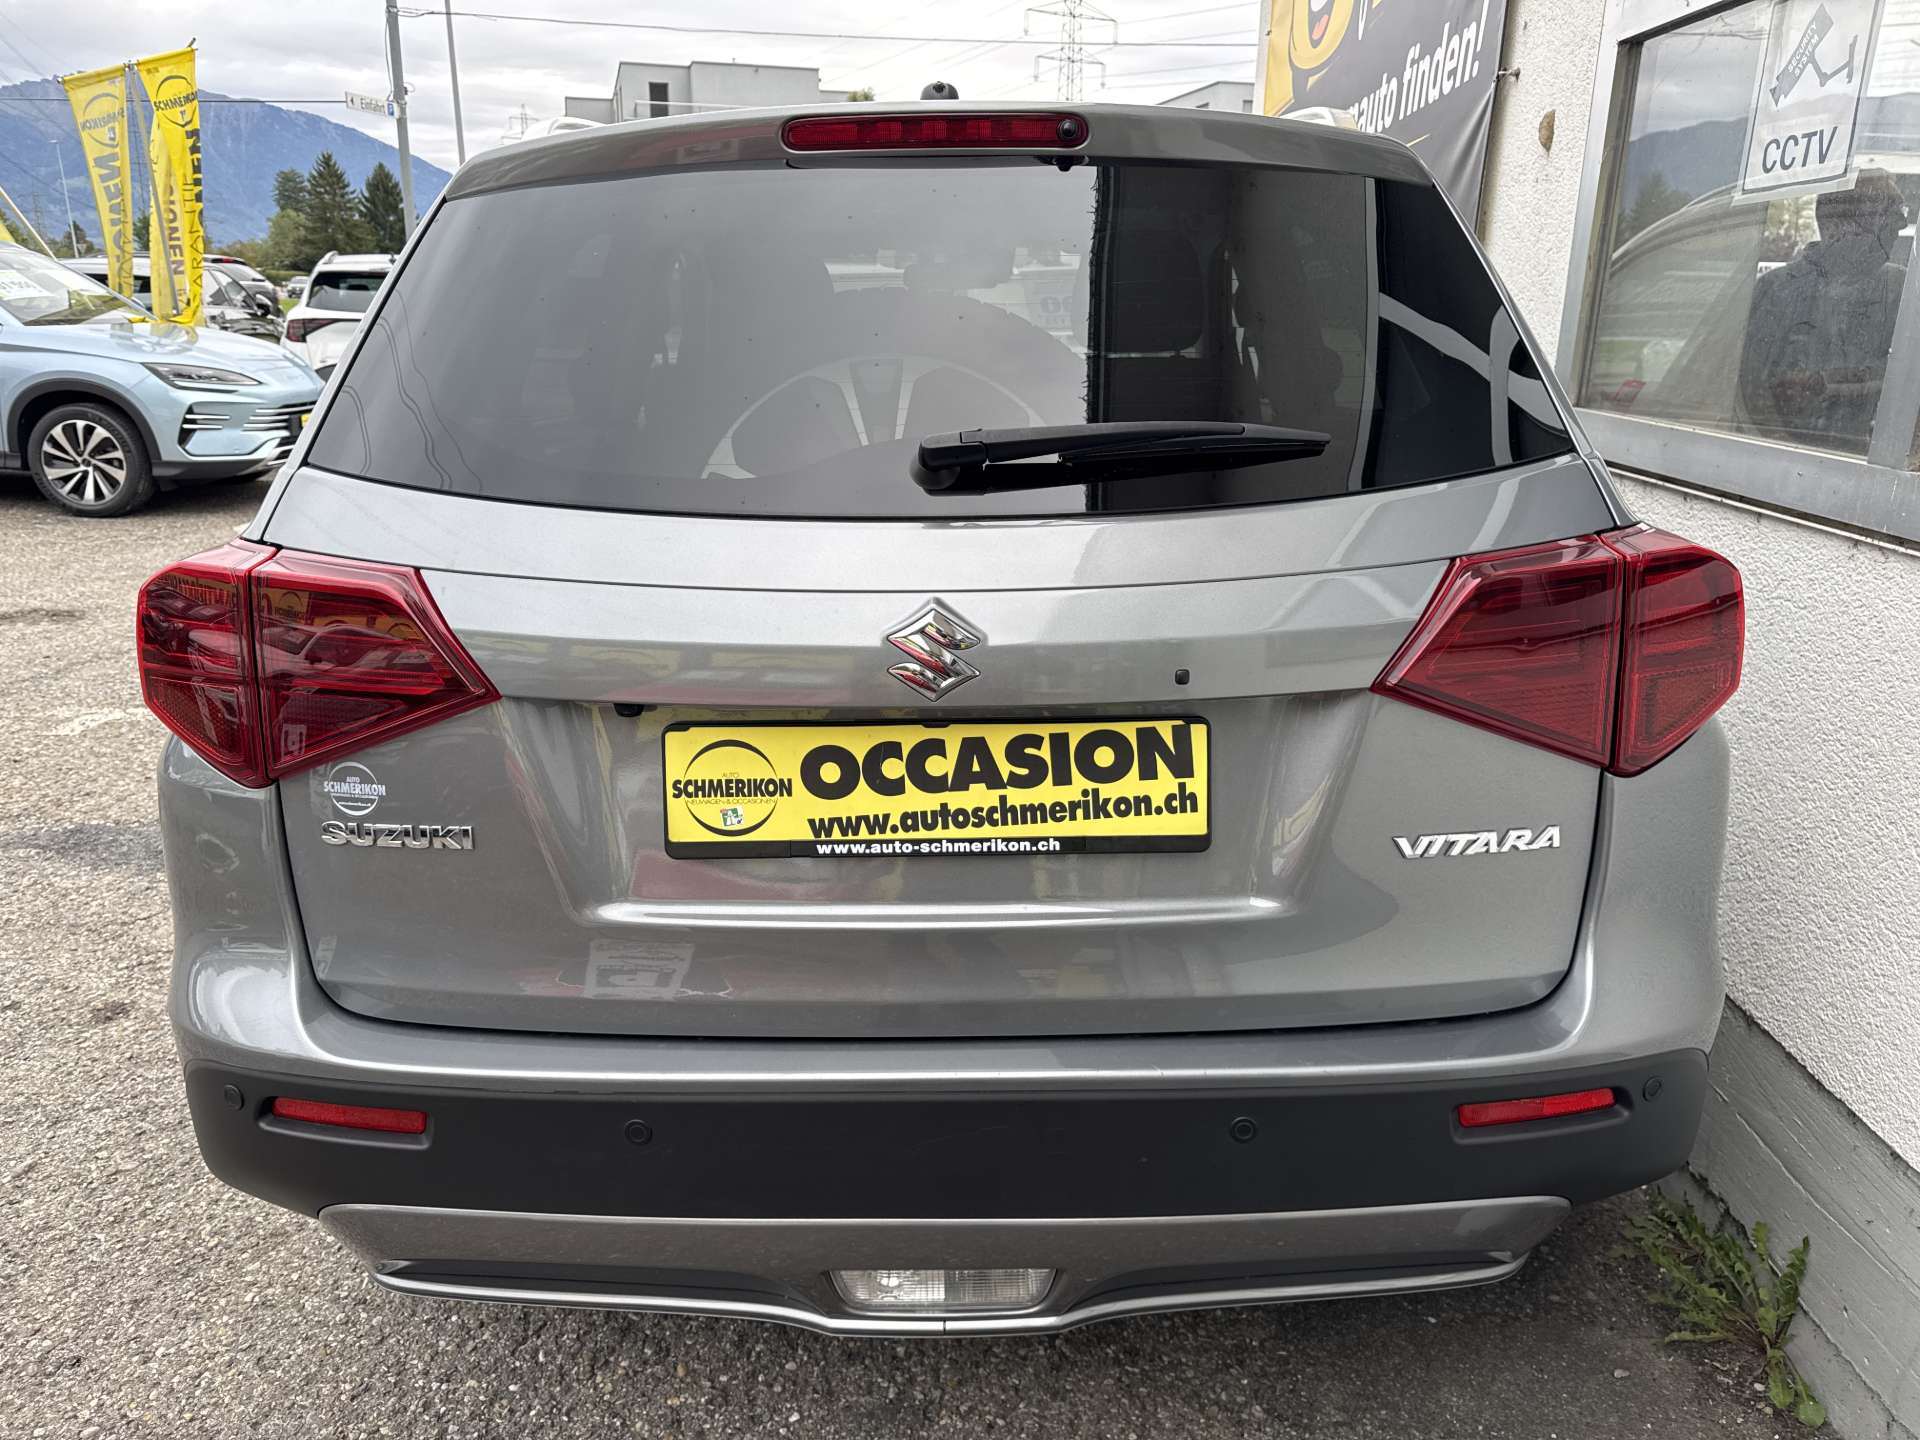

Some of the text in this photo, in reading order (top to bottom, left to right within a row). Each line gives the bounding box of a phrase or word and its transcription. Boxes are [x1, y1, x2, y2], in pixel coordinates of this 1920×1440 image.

[1399, 0, 1490, 121] finden!
[1787, 21, 1817, 73] SECURITY
[1794, 33, 1820, 78] SYSTEM
[1761, 125, 1839, 174] CCTV
[799, 723, 1195, 801] OCCASION
[323, 781, 386, 796] SCHMERIKON
[672, 778, 793, 798] SCHMERIKON
[807, 782, 1199, 839] www.autoschmerikon.ch
[320, 820, 474, 850] SUZUKI
[816, 837, 1061, 855] www.auto-schmerikon.ch
[1391, 825, 1561, 859] VITARA
